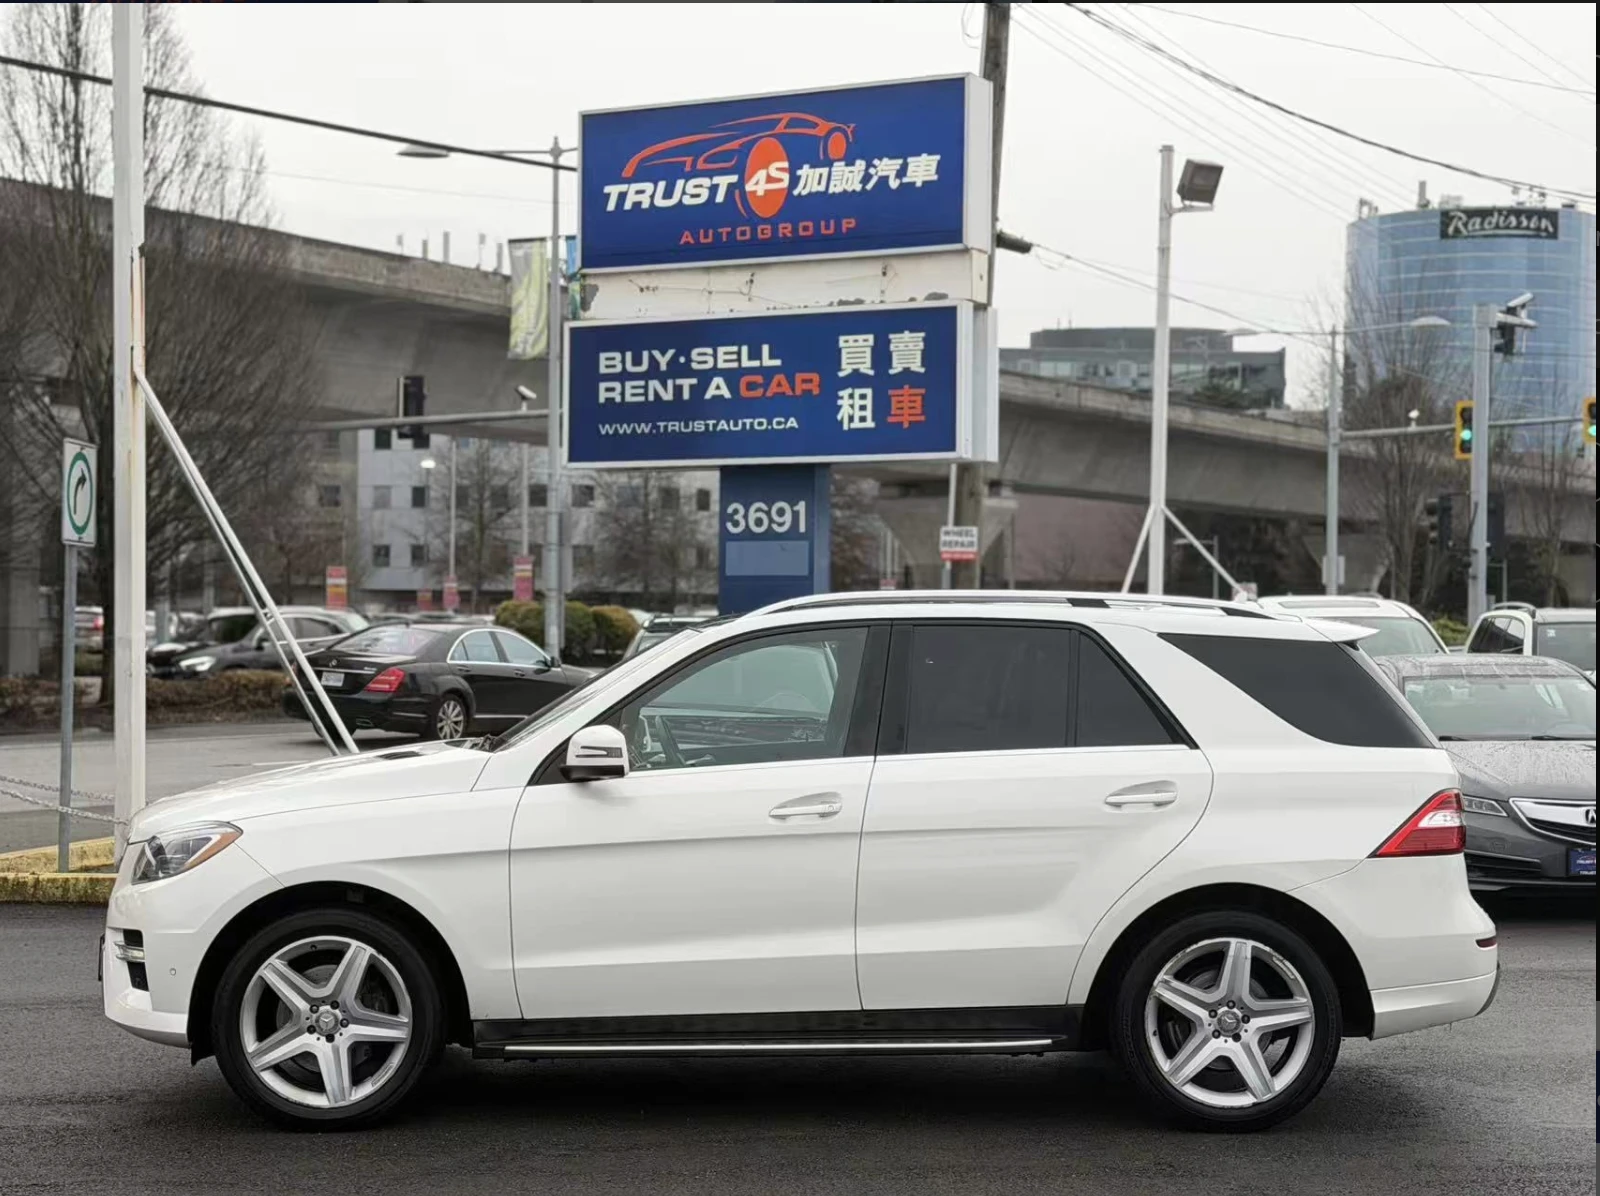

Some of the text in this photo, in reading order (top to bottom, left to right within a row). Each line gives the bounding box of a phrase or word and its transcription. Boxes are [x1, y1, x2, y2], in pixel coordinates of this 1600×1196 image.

[603, 153, 941, 212] TRUST 4S 加誠汽車
[680, 217, 857, 245] AUTOGROUP
[1447, 210, 1555, 236] Radisson
[838, 330, 926, 377] 買賣
[599, 372, 820, 403] RENT A CAR
[837, 385, 926, 431] 租車
[598, 416, 799, 435] WWW.TRUSTAUTO.CA
[725, 500, 806, 534] 3691
[942, 540, 975, 548] REPAIR
[943, 529, 974, 538] WHEEL
